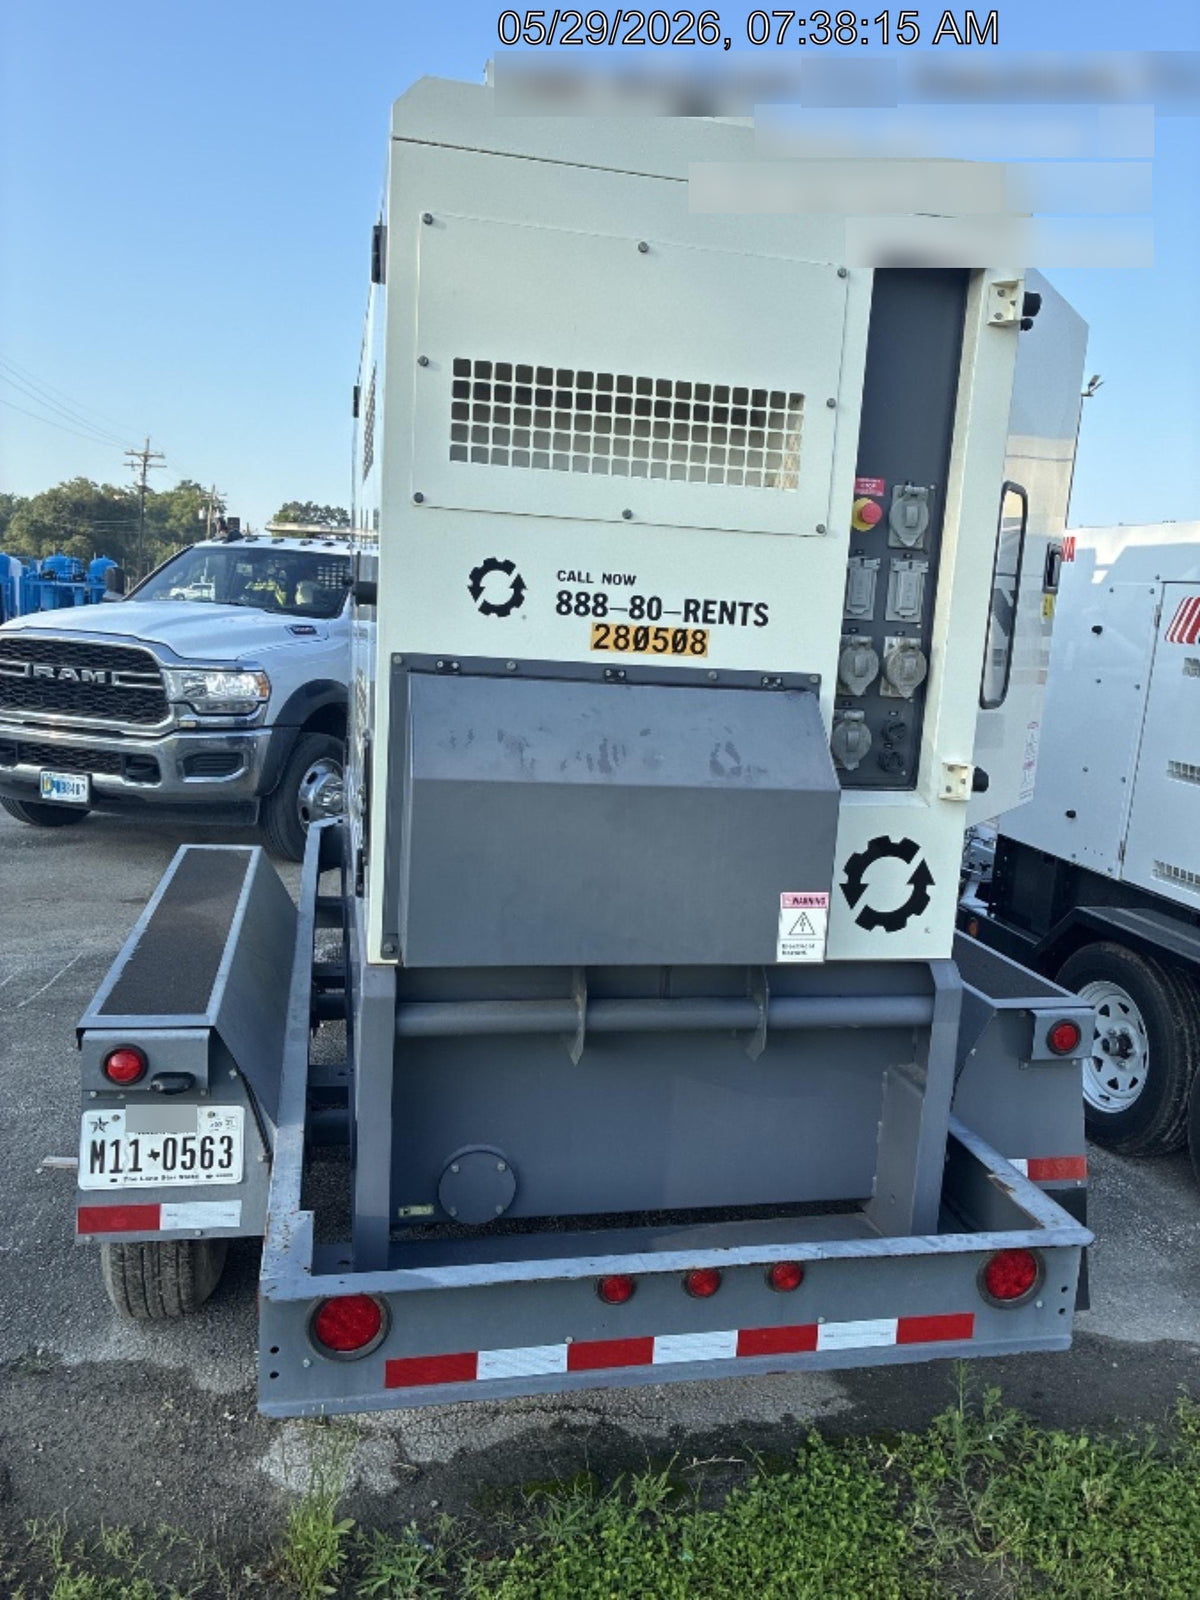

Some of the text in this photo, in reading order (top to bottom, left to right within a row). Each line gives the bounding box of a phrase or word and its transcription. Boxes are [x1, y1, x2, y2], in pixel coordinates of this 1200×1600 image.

[557, 570, 637, 586] CALL NOW
[593, 623, 707, 655] 280508
[33, 665, 106, 683] RAM
